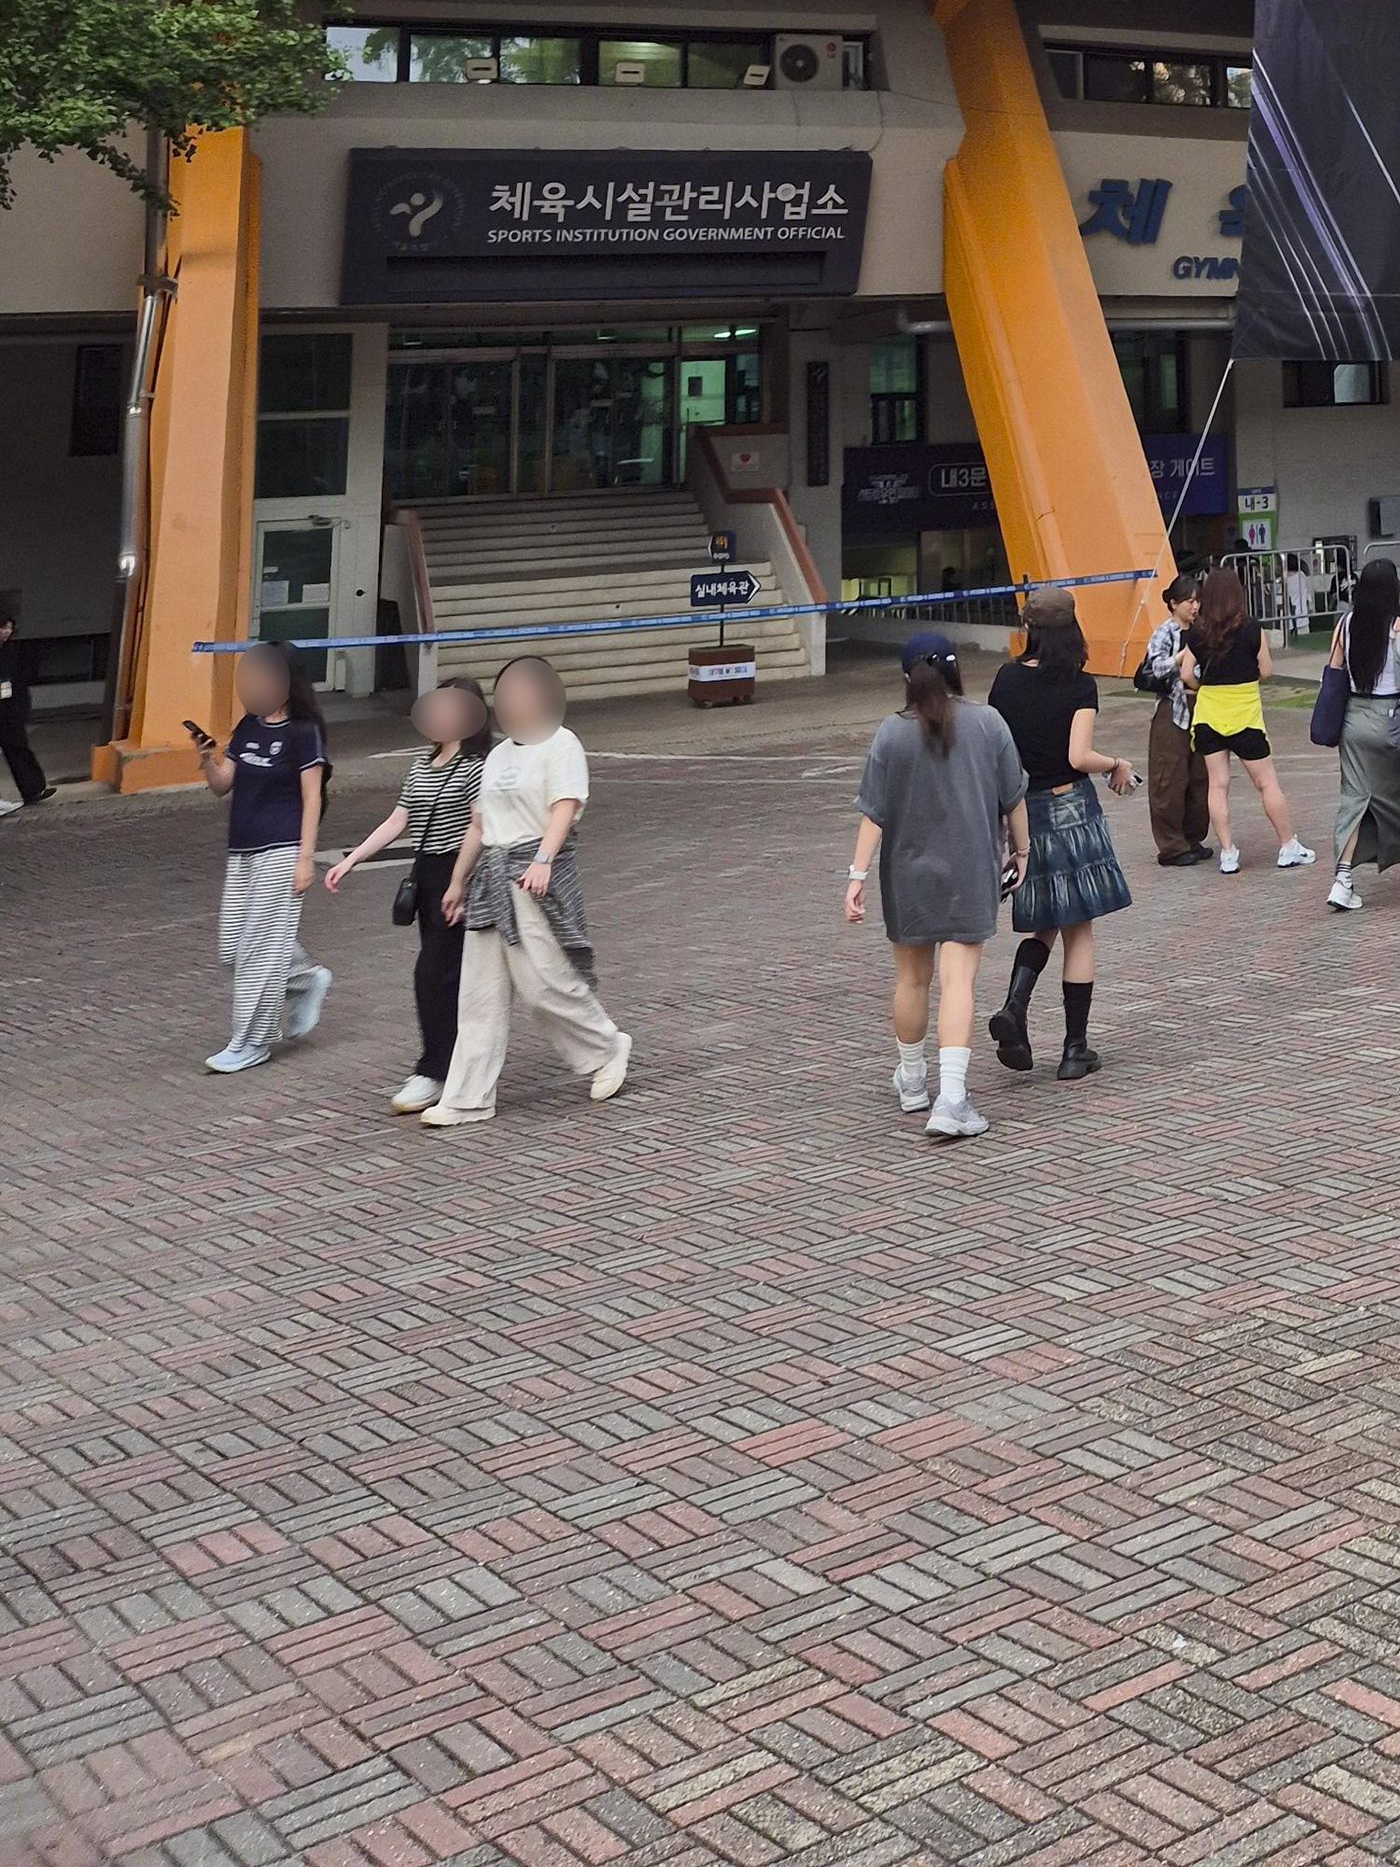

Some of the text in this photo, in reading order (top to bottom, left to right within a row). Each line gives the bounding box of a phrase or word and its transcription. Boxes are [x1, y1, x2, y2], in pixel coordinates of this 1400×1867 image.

[488, 181, 849, 222] 체육시설관리사업소
[486, 225, 845, 243] SPORTS INSTITUTION GOVERNMENT OFFICIAL
[1244, 496, 1269, 511] 내-3
[695, 580, 750, 599] 실내체육관
